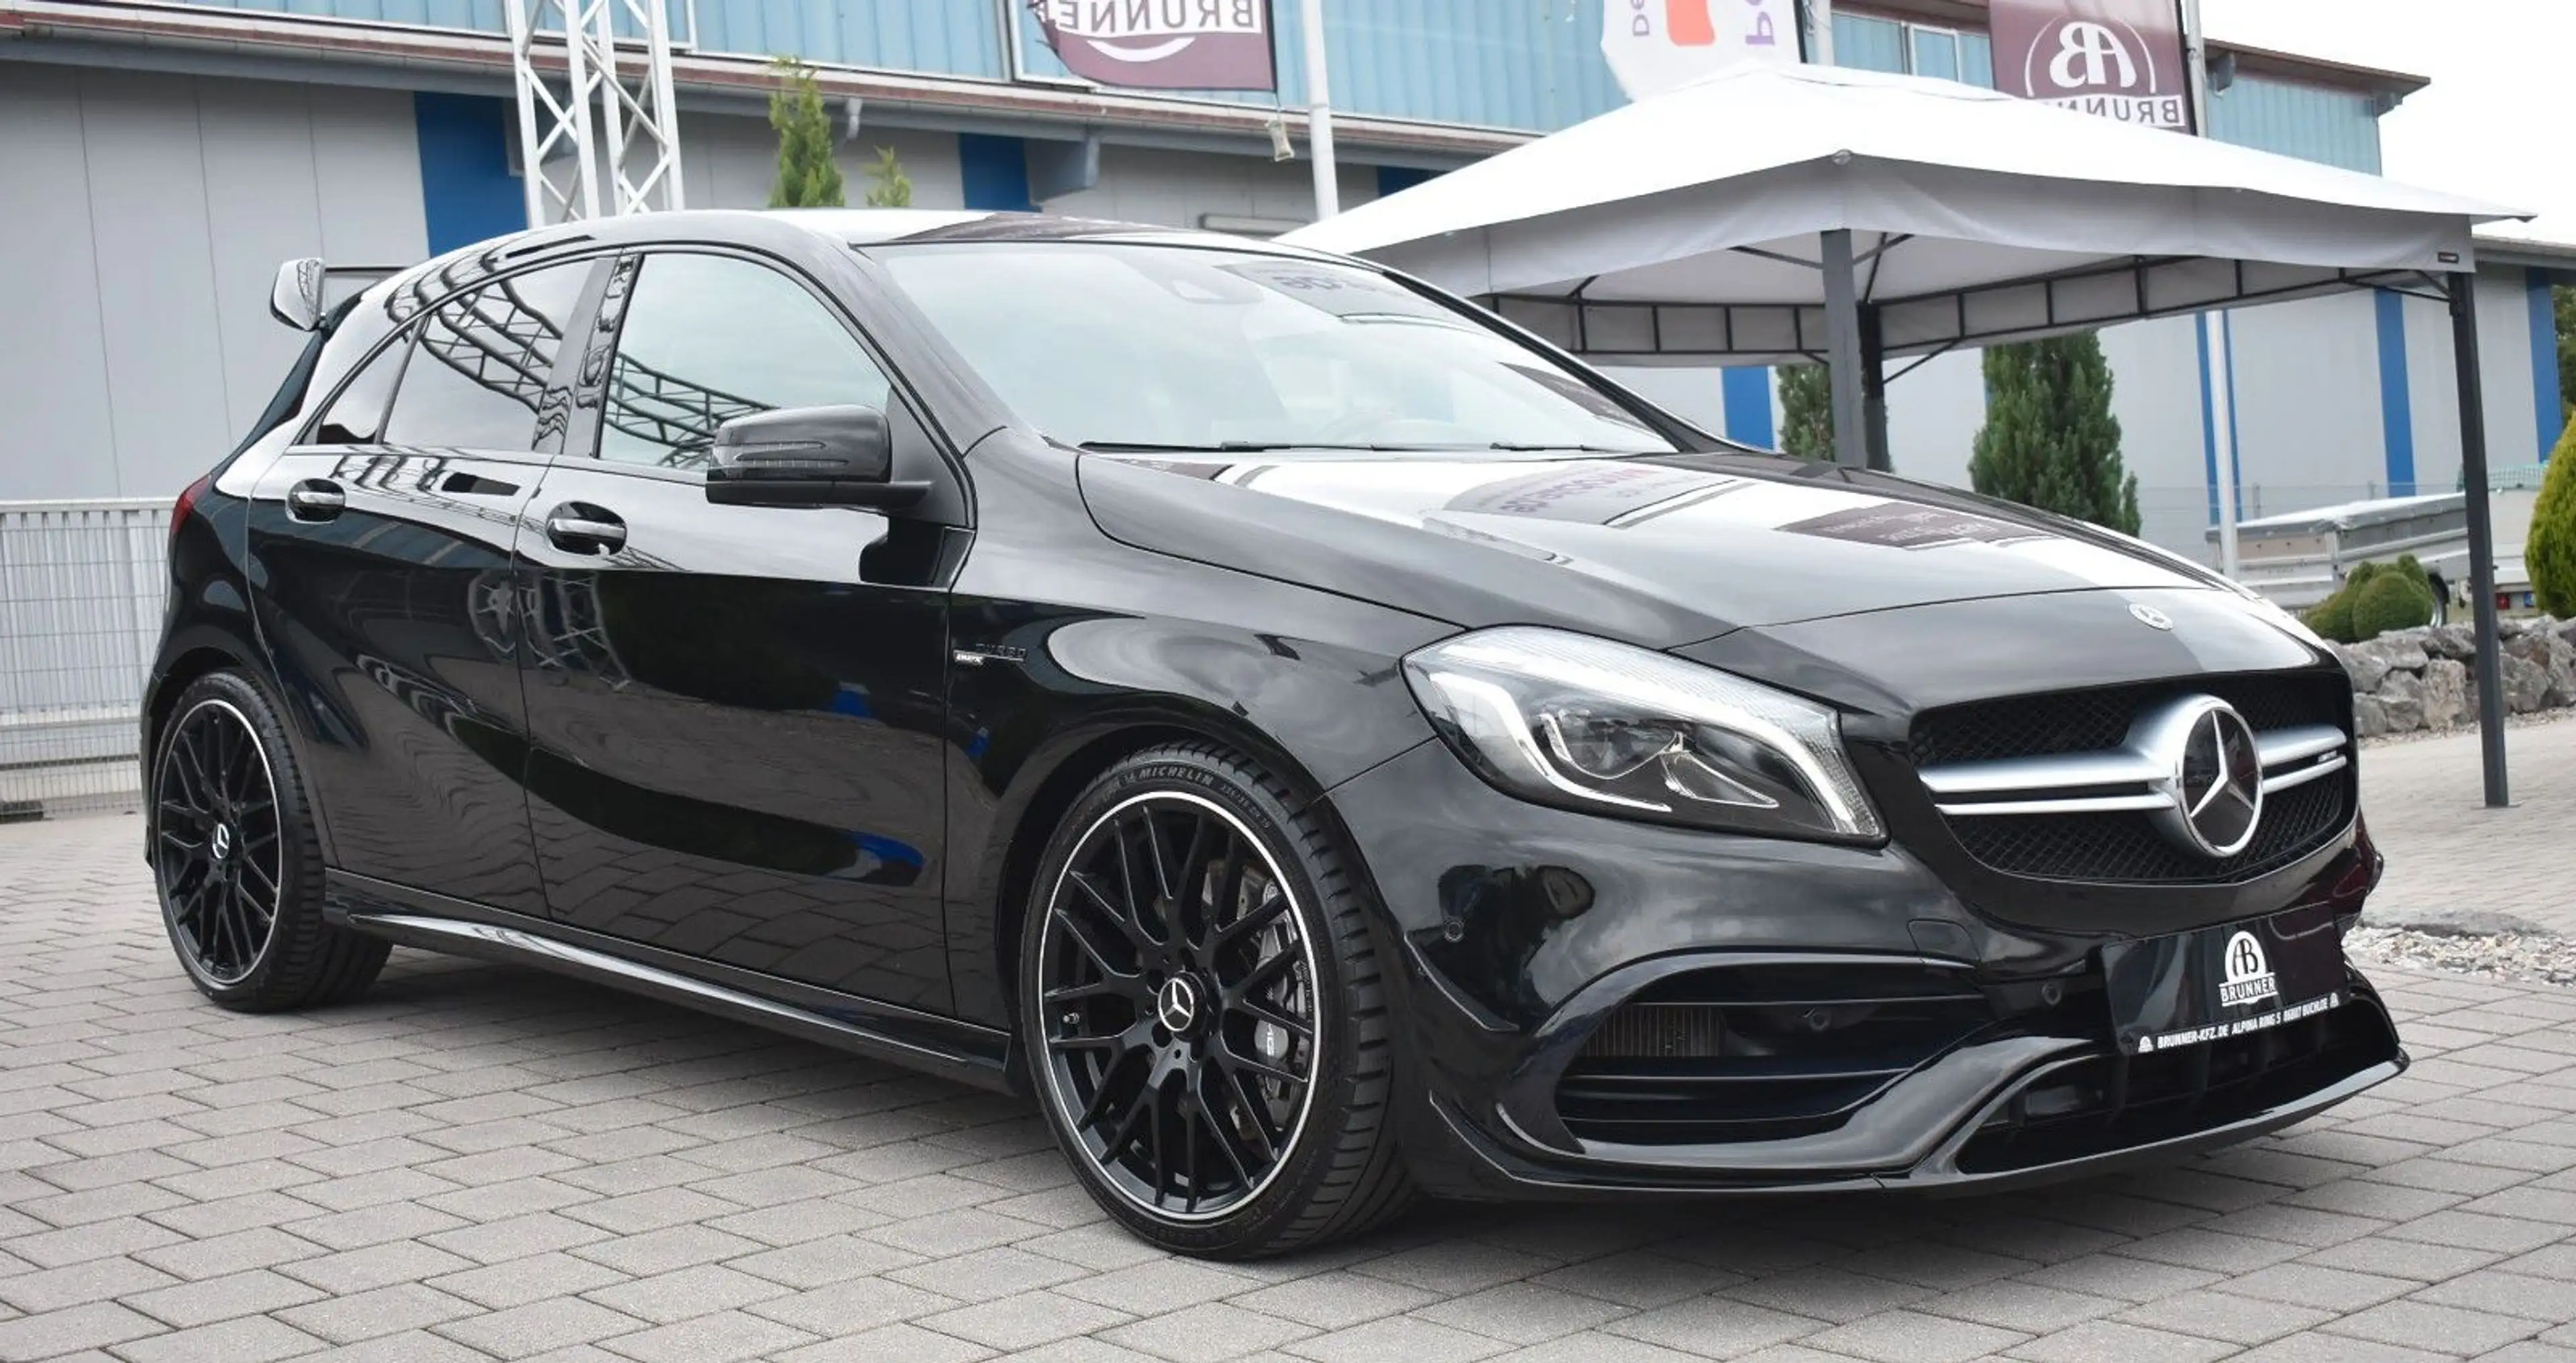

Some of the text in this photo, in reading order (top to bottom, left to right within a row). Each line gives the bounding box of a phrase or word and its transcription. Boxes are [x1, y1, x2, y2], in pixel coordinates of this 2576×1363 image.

[1139, 766, 1214, 787] MICHELIN
[2220, 977, 2276, 1002] BRUNNER
[2231, 1018, 2258, 1034] ALPINA
[2259, 1014, 2276, 1028] RING
